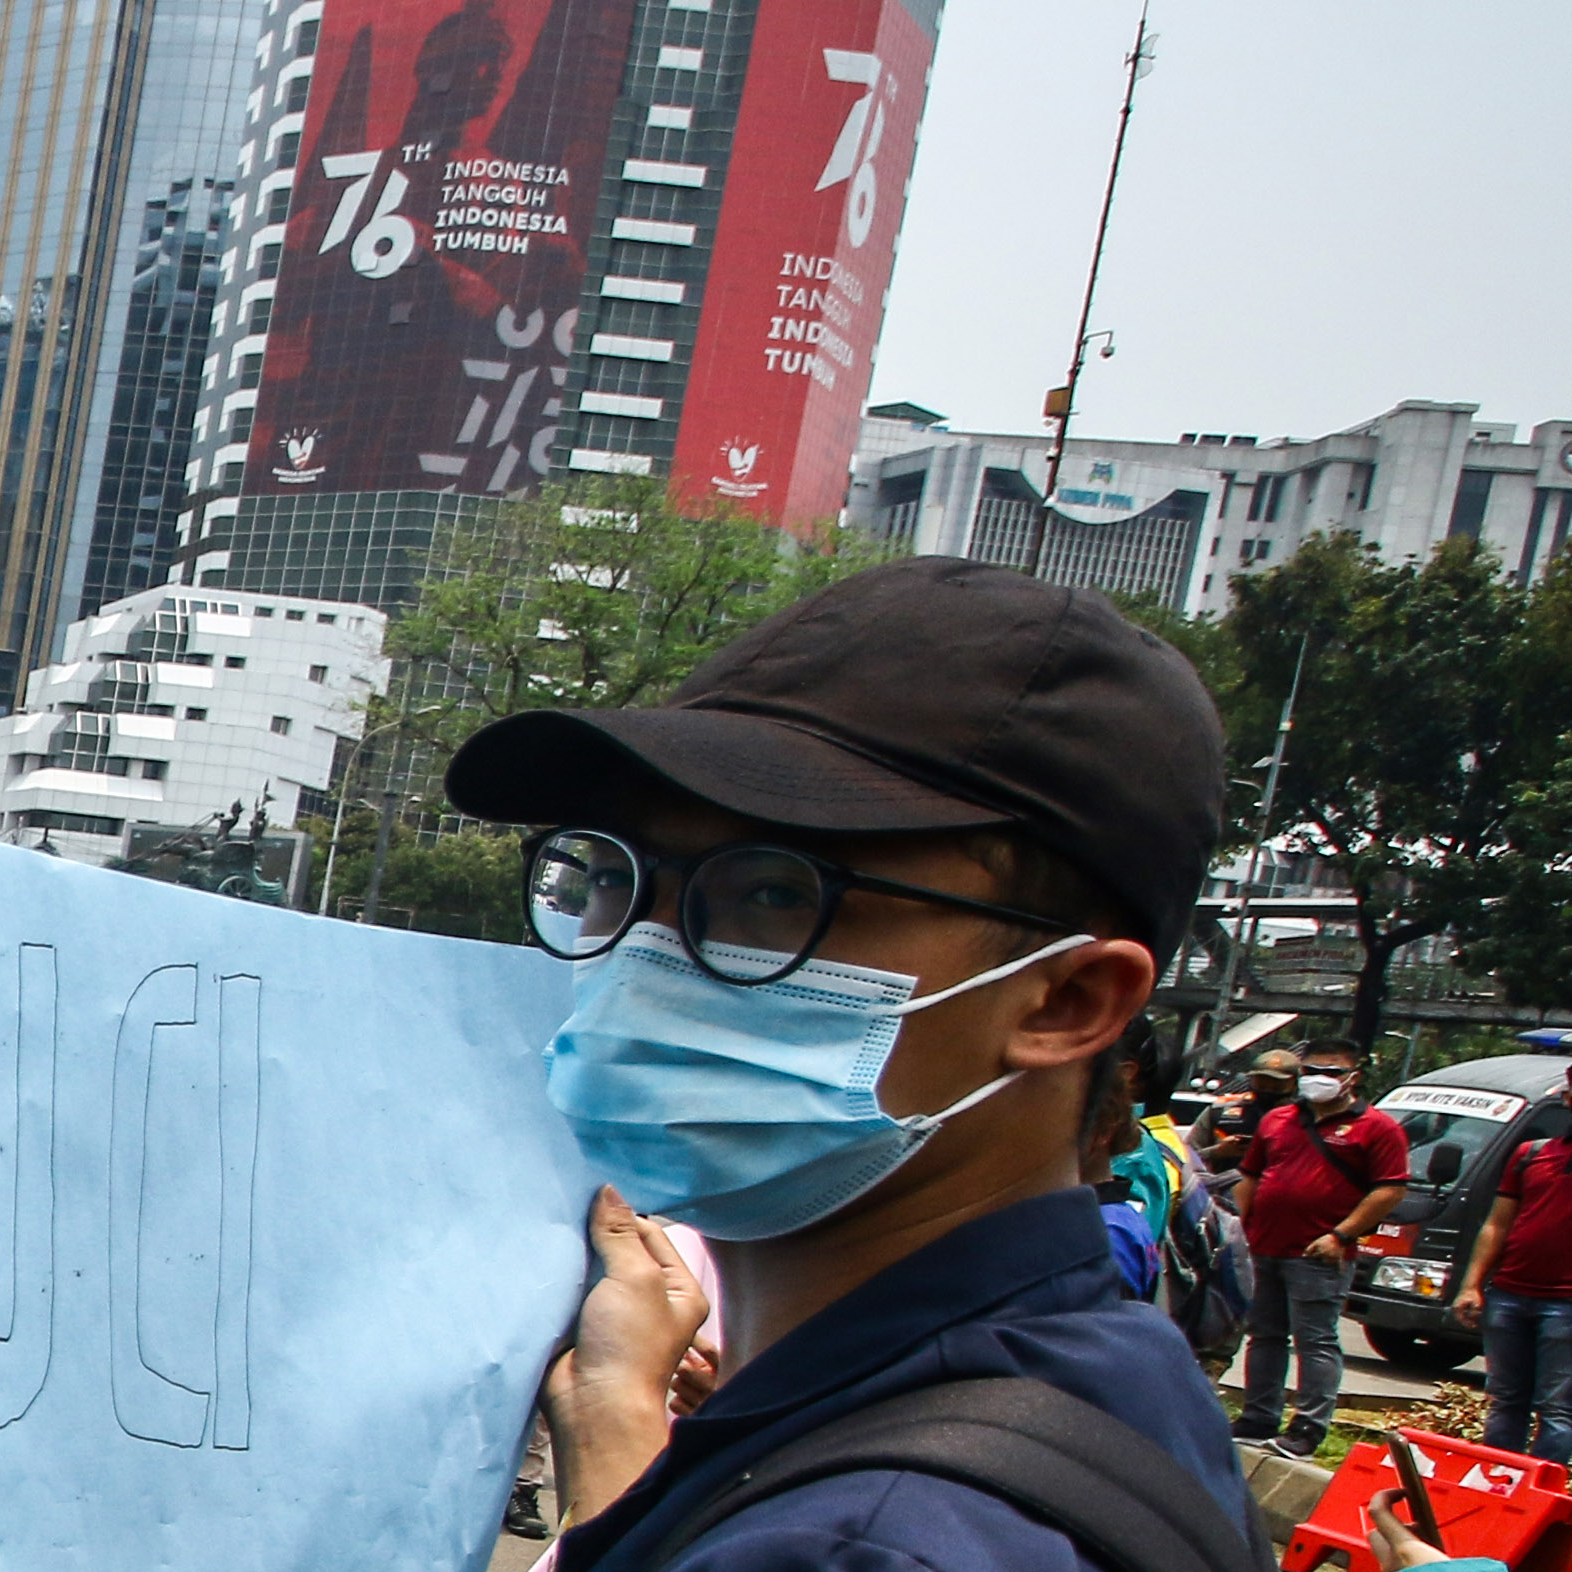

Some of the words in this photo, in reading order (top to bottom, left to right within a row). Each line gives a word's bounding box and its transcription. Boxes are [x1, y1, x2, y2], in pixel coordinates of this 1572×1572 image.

[814, 48, 884, 248] 76
[443, 159, 571, 186] INDONESIA
[440, 183, 548, 208] TANGGUH
[318, 150, 415, 279] 76
[402, 142, 433, 163] TH
[434, 206, 569, 235] INDONESIA
[432, 230, 530, 255] TUMBUH
